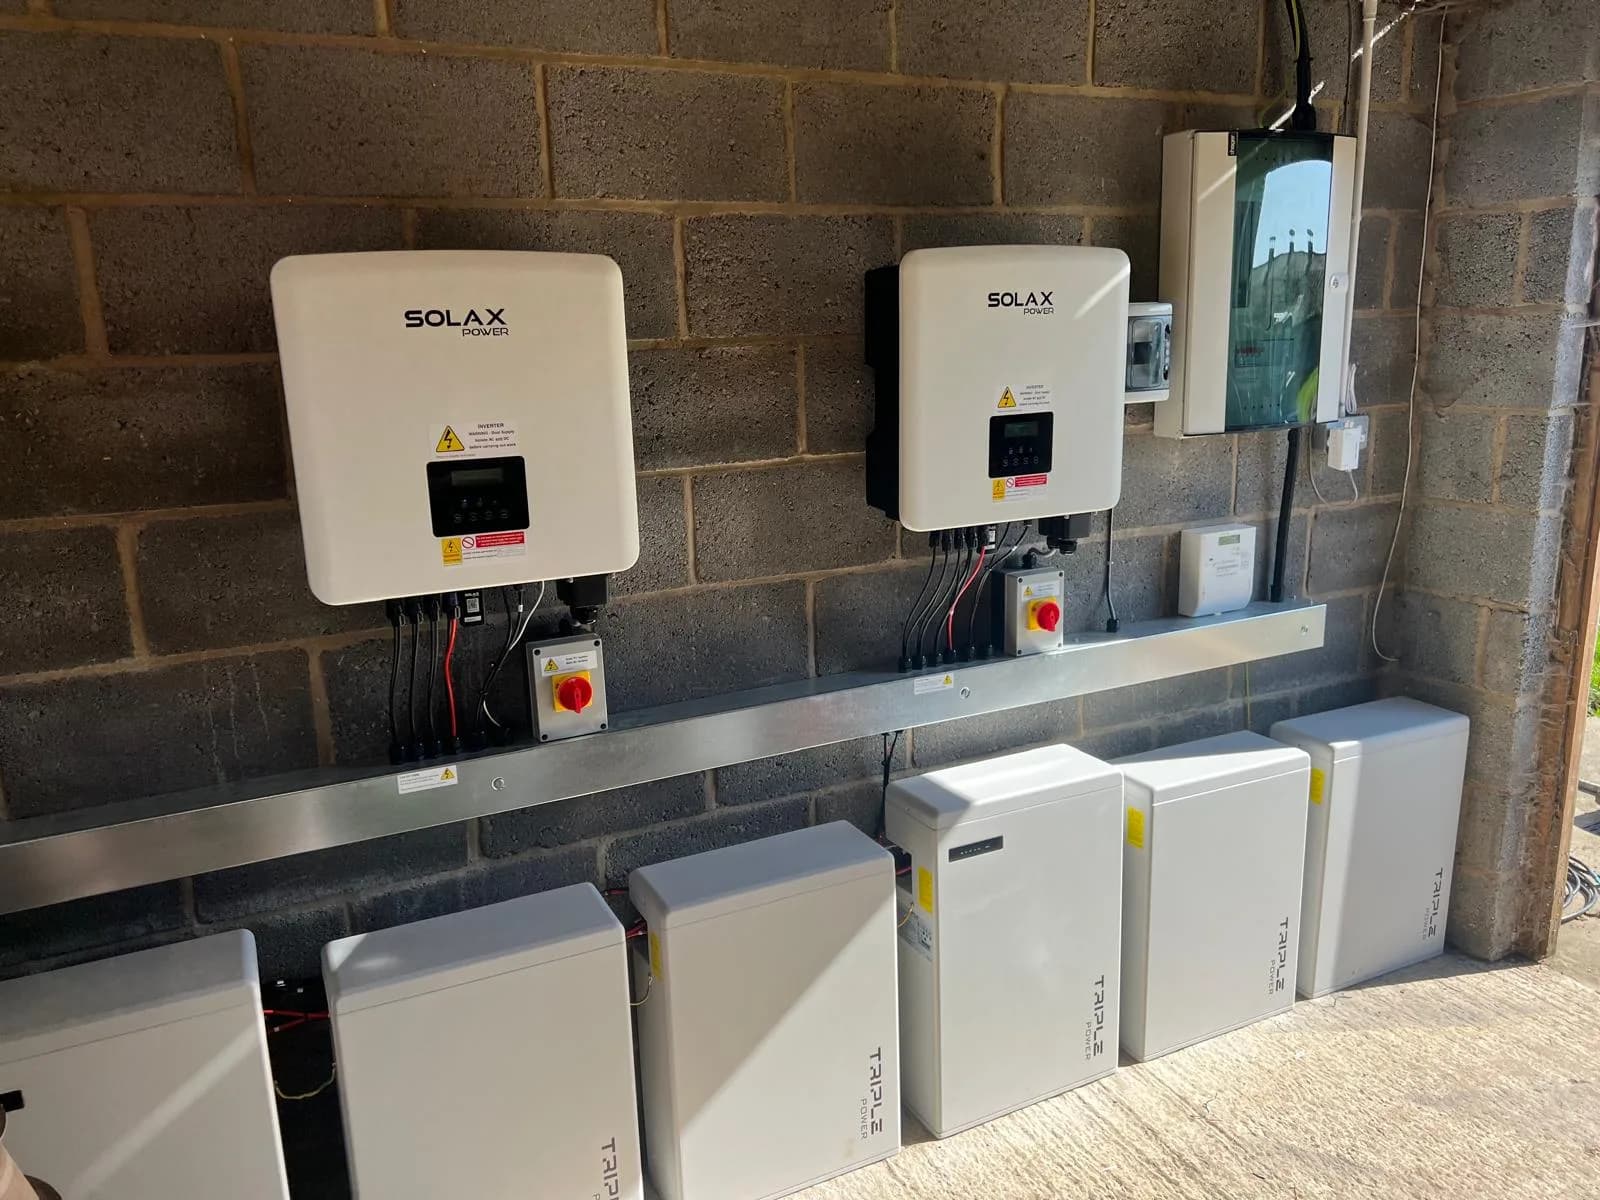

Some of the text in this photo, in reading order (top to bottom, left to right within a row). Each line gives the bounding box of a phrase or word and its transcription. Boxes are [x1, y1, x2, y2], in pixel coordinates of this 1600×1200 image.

[404, 308, 507, 328] SOLAX
[987, 291, 1054, 307] SOLAX
[1023, 307, 1055, 315] POWER
[462, 327, 510, 337] POWER
[1428, 867, 1443, 938] TRIPLE
[1276, 916, 1289, 992] TRIPLE
[1268, 959, 1276, 995] POWER
[1093, 974, 1104, 1057] TRIPLE
[869, 1046, 883, 1135] TRIPLE
[860, 1098, 868, 1140] POWER
[601, 1136, 619, 1200] TRIP
